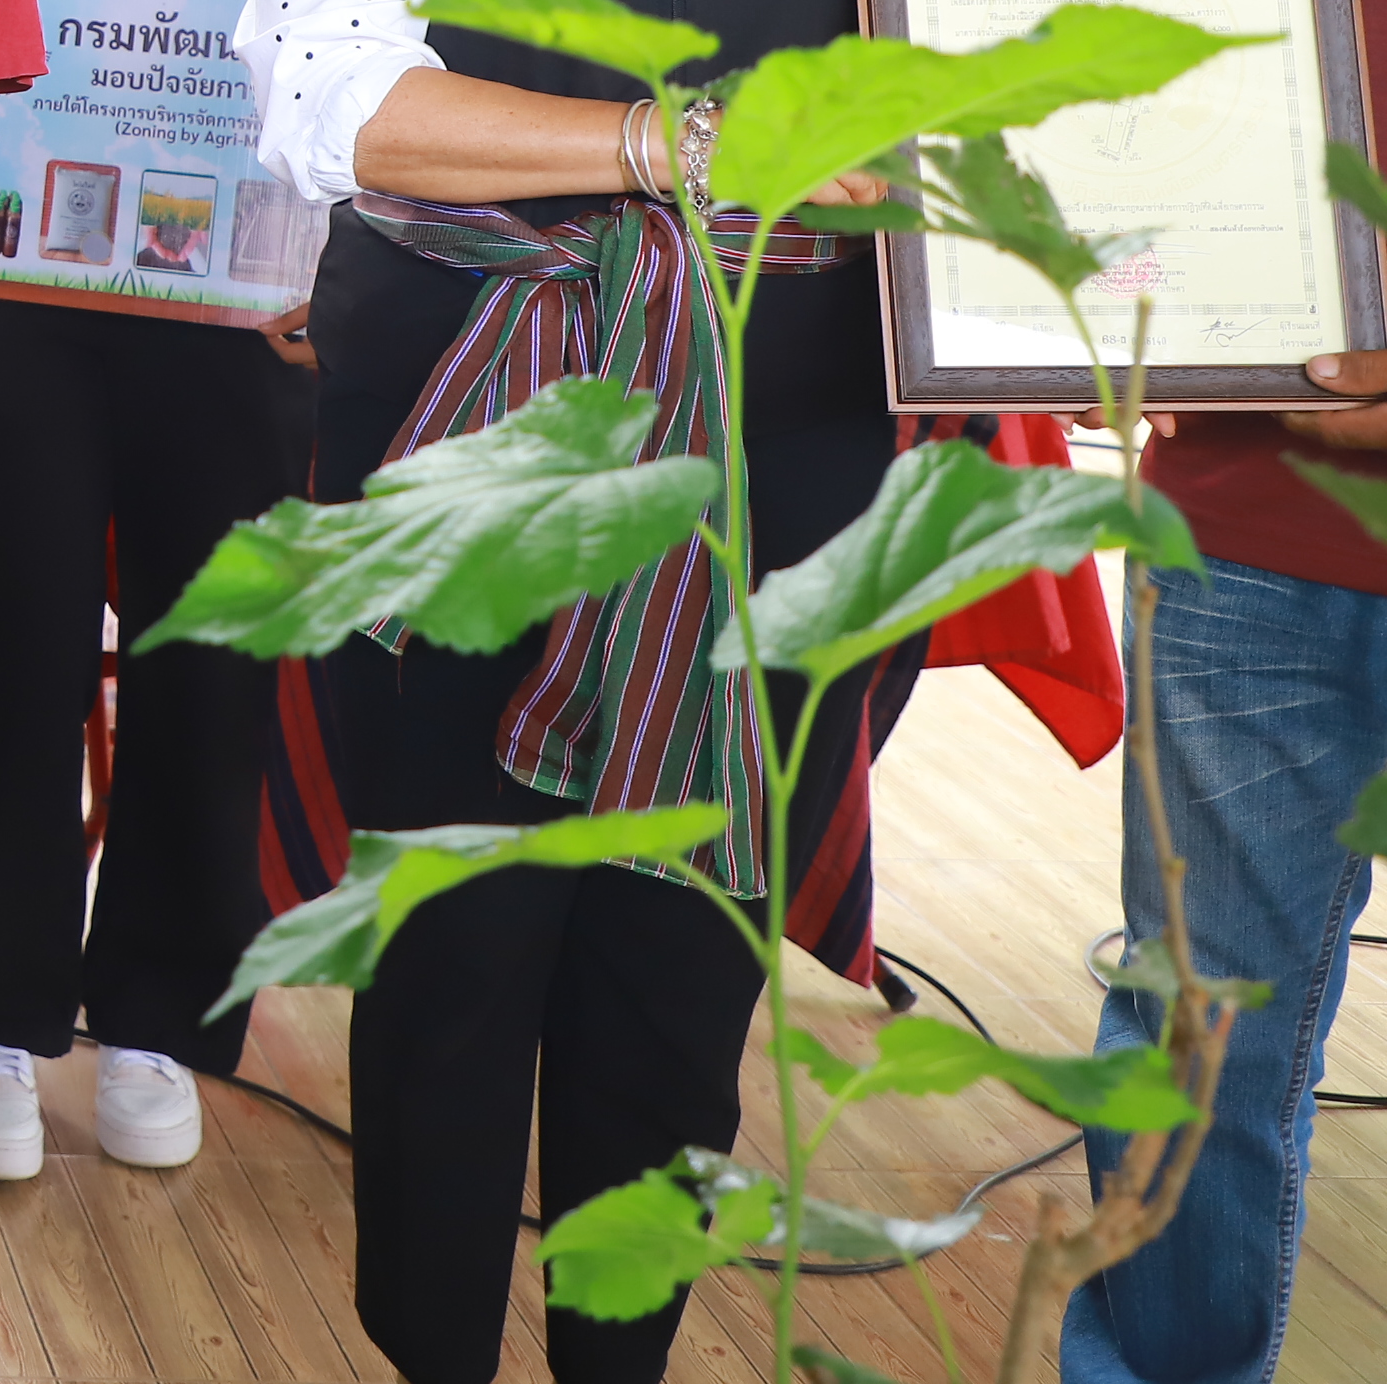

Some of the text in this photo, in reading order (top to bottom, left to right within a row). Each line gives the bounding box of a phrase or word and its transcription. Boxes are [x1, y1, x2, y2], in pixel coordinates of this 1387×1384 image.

[91, 65, 255, 101] มอบปัจจัยกา
[115, 121, 175, 145] (Zoning
[181, 126, 200, 146] by
